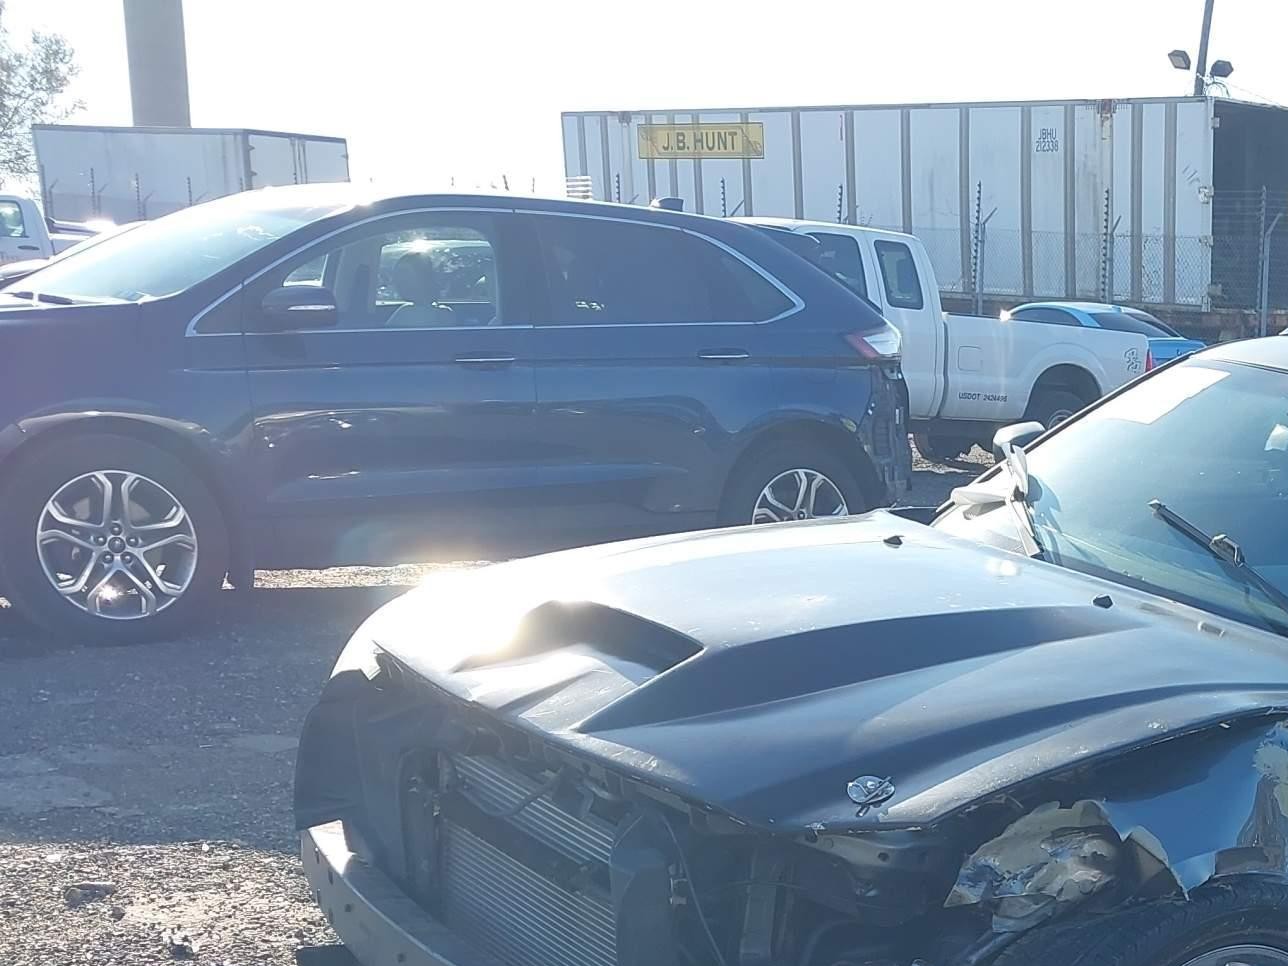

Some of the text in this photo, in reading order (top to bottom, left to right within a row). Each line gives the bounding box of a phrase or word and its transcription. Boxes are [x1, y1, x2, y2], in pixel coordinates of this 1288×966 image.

[1038, 127, 1057, 140] JBHU
[693, 131, 738, 151] HUNT
[958, 391, 981, 401] USDOT
